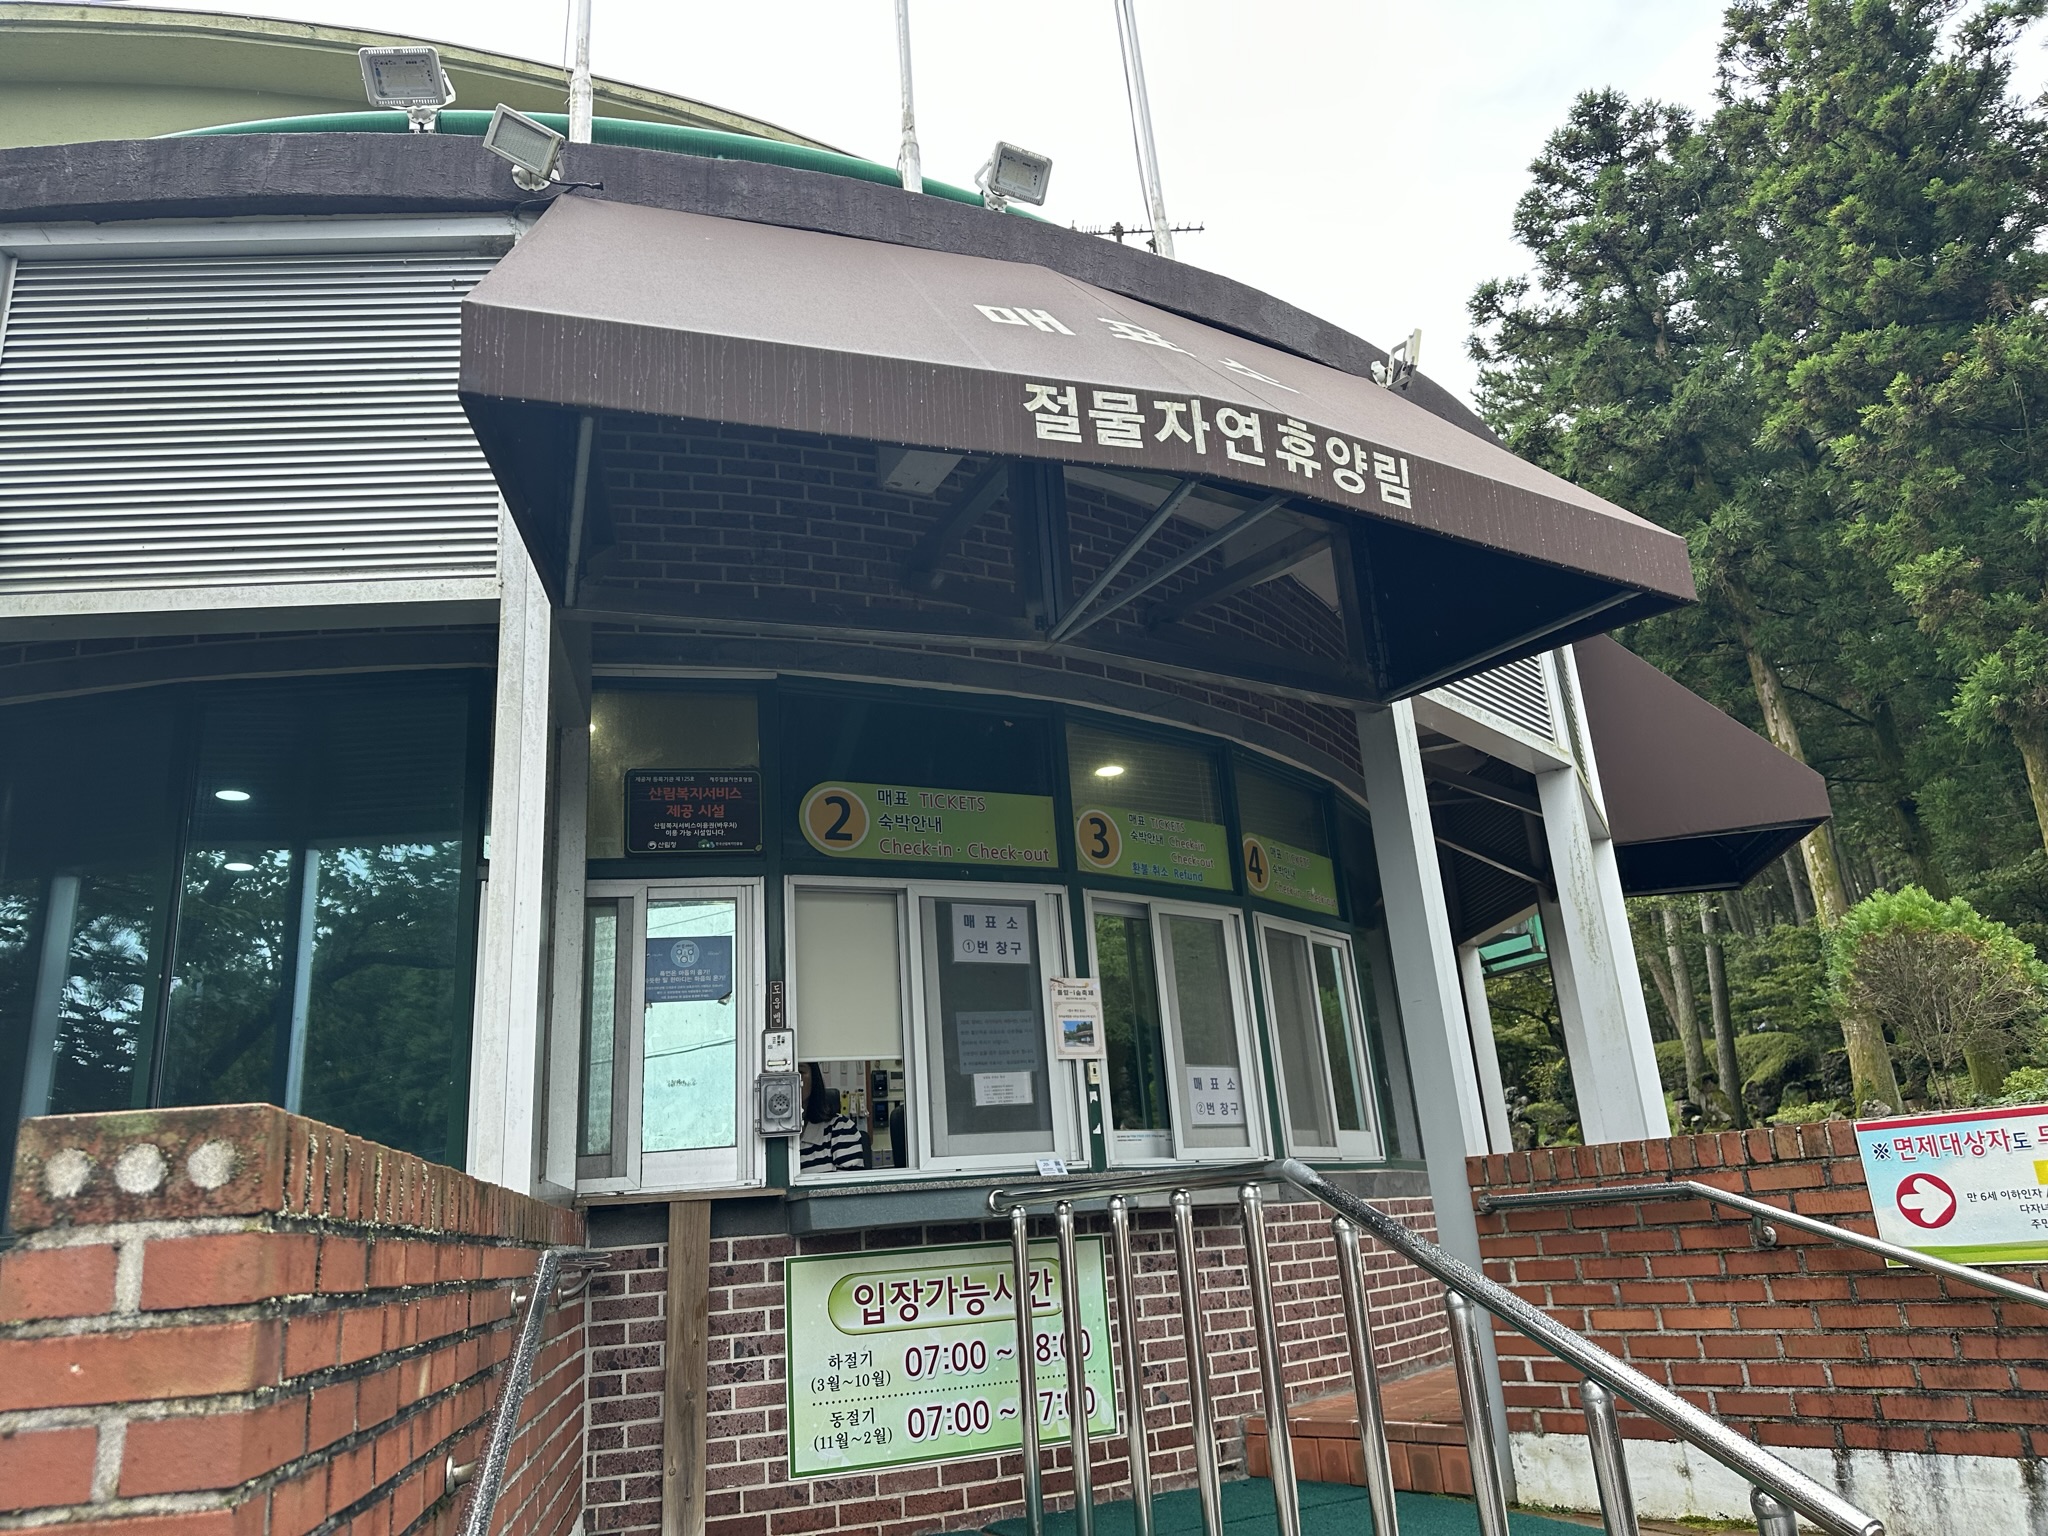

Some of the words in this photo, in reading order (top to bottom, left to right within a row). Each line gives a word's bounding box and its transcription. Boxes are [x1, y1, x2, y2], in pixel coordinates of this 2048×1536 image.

[1022, 382, 1413, 509] 절물자연휴양림
[648, 787, 742, 800] 산림복지서비스
[877, 789, 910, 806] 매표
[918, 792, 986, 812] TICKETS
[666, 804, 694, 818] 제공
[698, 804, 725, 818] 시설
[824, 795, 853, 841] 2
[665, 829, 678, 837] 이용
[679, 829, 692, 837] 가능
[693, 829, 726, 837] 시설입니다.
[878, 813, 943, 833] 숙박안내
[1128, 813, 1146, 826] 매표
[1150, 817, 1186, 833] TICKETS
[657, 841, 677, 849] 산림청
[1088, 817, 1111, 859] 3
[1130, 830, 1164, 846] 숙박안내
[1168, 836, 1206, 851] Check-in
[879, 838, 953, 857] Check-in
[967, 843, 1051, 862] Check-out
[1170, 852, 1214, 868] Check-out
[1270, 846, 1282, 860] 매표
[1285, 851, 1311, 869] TICKETS
[1132, 861, 1149, 875] 환불
[1152, 864, 1169, 877] 취소
[1173, 868, 1203, 882] Refund
[1248, 846, 1263, 883] 4
[1273, 864, 1297, 880] 숙박안내
[996, 940, 1022, 955] 창구
[1219, 1102, 1240, 1116] 창구
[1966, 1192, 1978, 1203] 만
[1980, 1190, 1998, 1201] 6세
[2000, 1188, 2043, 1201] 이하인자
[827, 1350, 874, 1371] 하절기
[904, 1340, 987, 1377] 07:00
[1035, 1329, 1091, 1362] 8:0
[810, 1369, 892, 1394] (3월~10월)
[828, 1406, 876, 1429] 동절기
[906, 1399, 991, 1438] 07:00
[1039, 1386, 1096, 1421] 7:0
[812, 1430, 894, 1453] (11월~2월)
